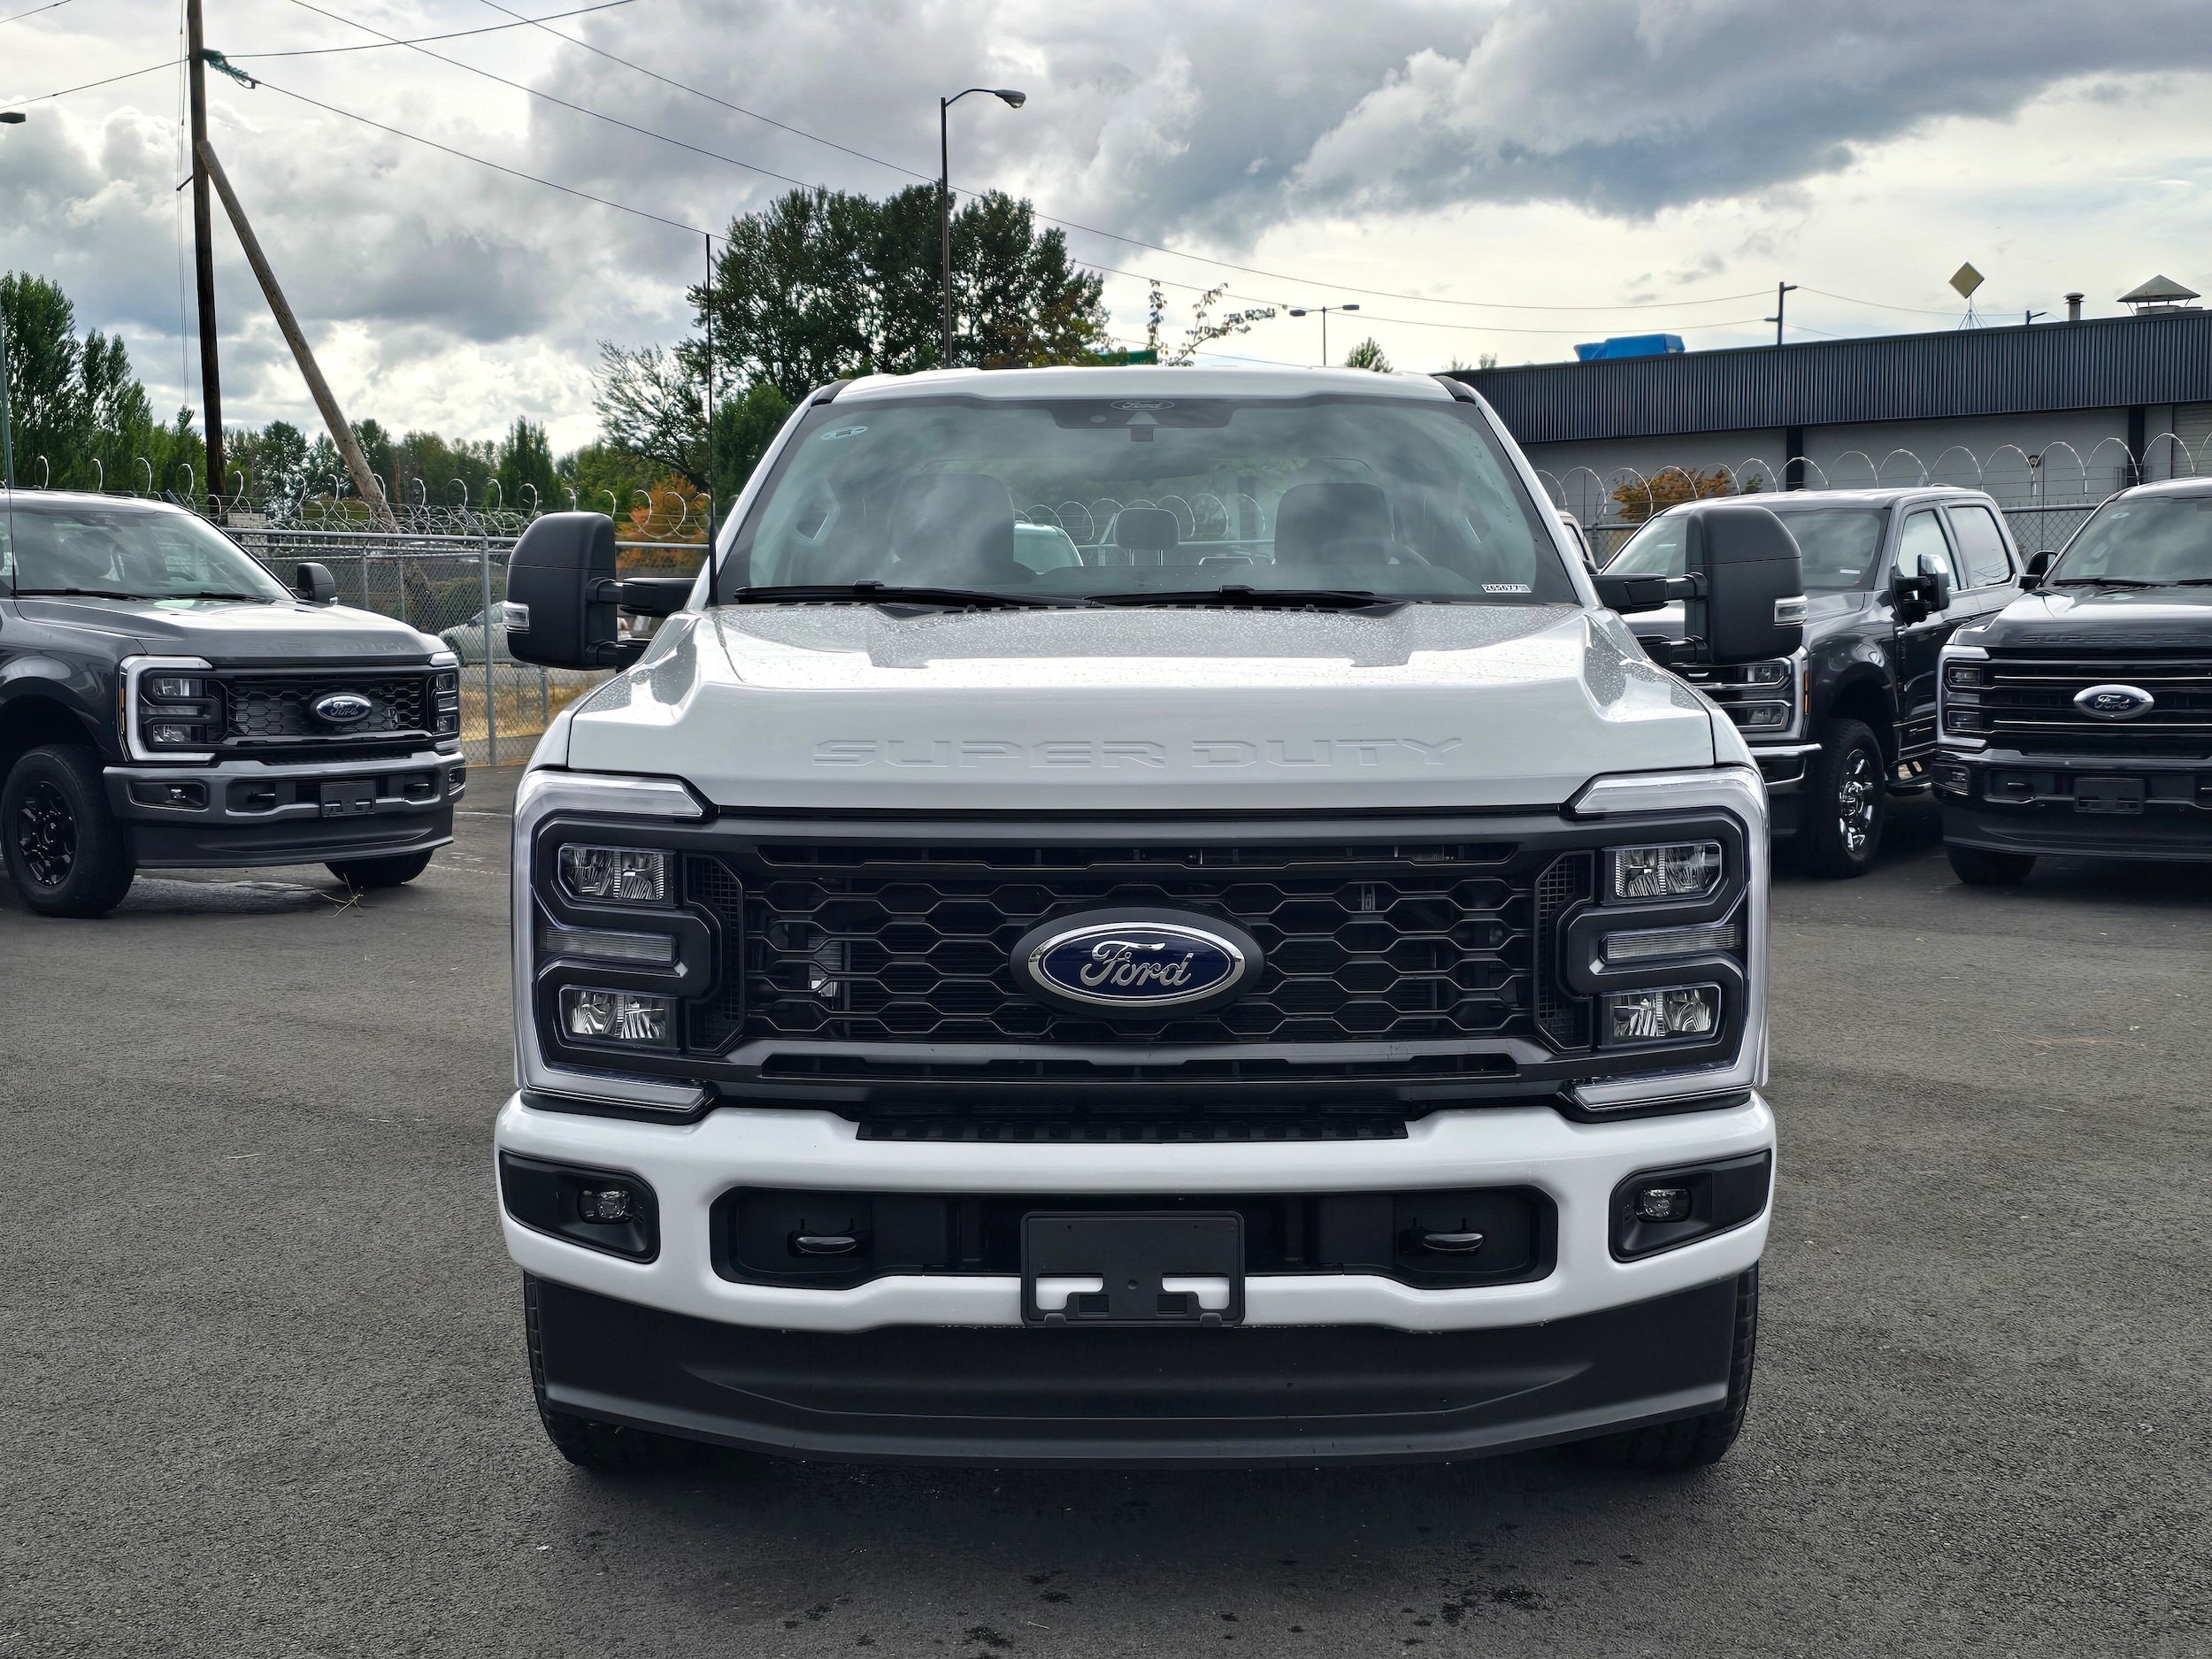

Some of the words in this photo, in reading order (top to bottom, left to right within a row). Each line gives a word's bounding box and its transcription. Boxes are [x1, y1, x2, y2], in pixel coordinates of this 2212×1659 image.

[329, 700, 358, 717] Ford
[2093, 694, 2131, 710] Ford
[812, 740, 1166, 768] SUPER
[1191, 737, 1463, 768] DUTY
[1079, 940, 1193, 987] Ford
